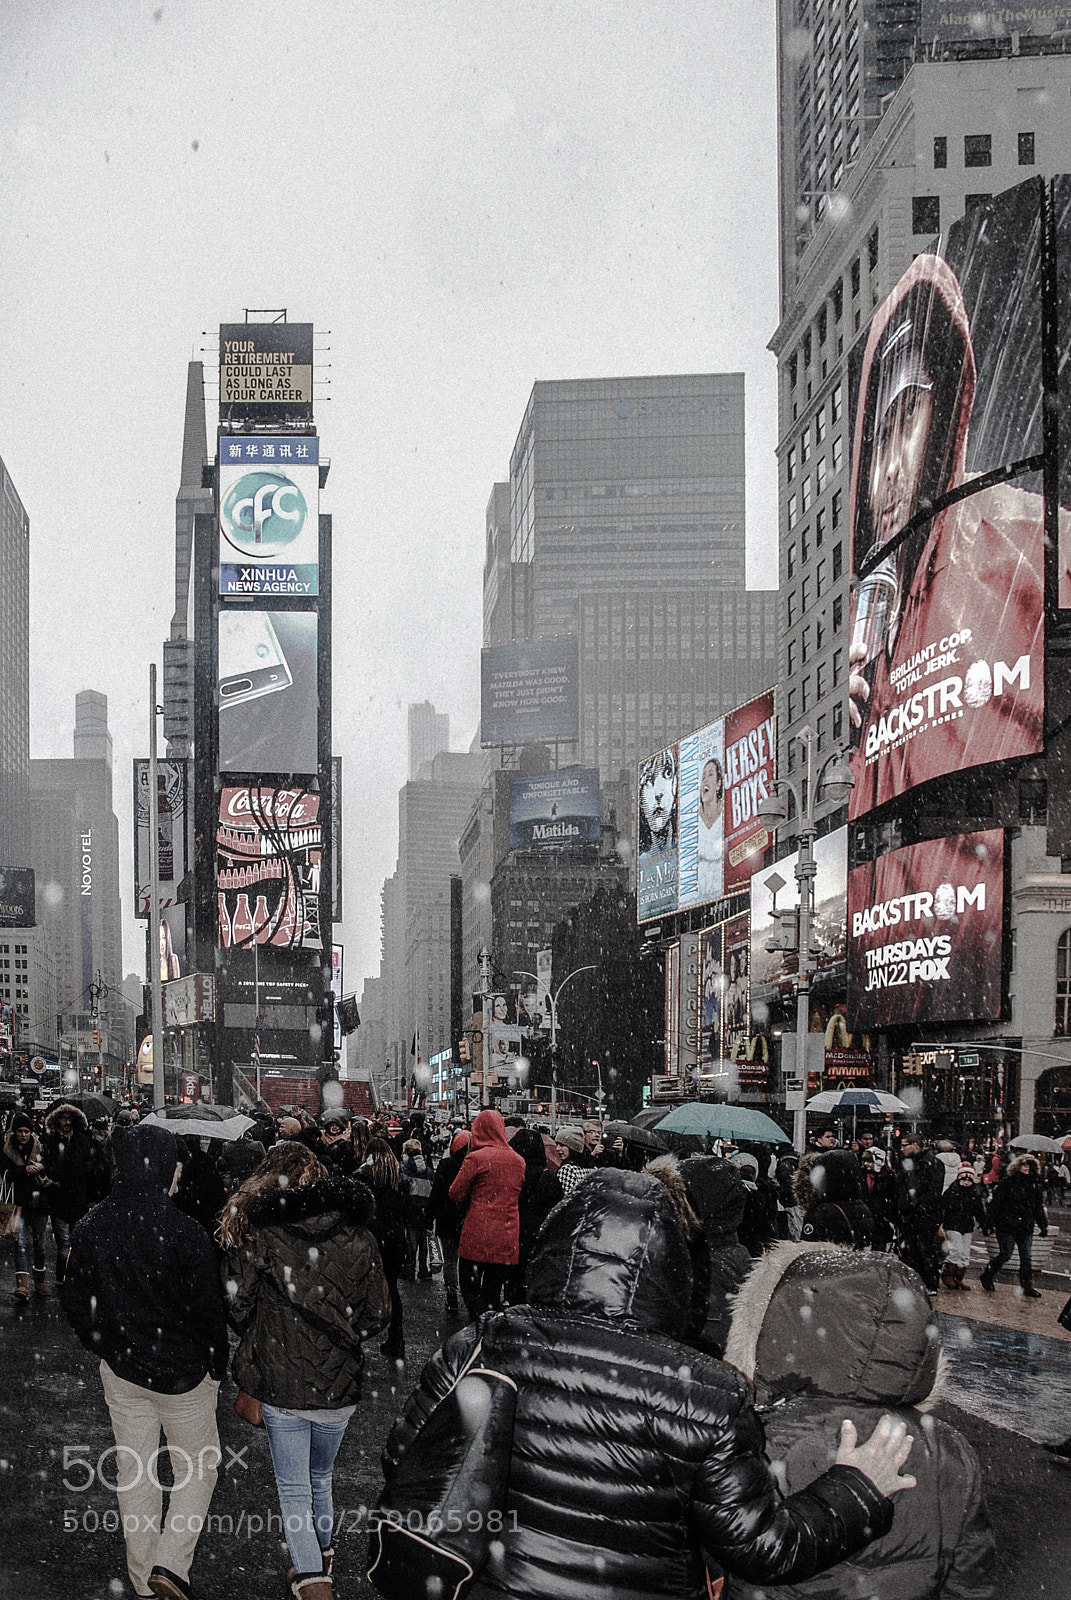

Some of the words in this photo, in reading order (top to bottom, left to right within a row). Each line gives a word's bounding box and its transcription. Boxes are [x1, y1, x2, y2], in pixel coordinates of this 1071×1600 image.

[224, 340, 255, 352] YOUR
[224, 352, 295, 364] RETIREMENT
[226, 366, 262, 377] COULD
[265, 366, 293, 377] LAST
[226, 378, 240, 389] AS
[244, 378, 273, 389] LONG
[276, 378, 291, 389] AS
[226, 389, 256, 400] YOUR
[259, 389, 303, 400] CAREER
[228, 444, 309, 458] 新华通讯社
[240, 568, 298, 581] XINHUA
[227, 582, 260, 592] NEWS
[263, 582, 311, 592] AGENCY
[890, 642, 937, 685] BRILLIANT
[939, 628, 973, 652] COP.
[895, 667, 922, 695] TOTAL
[923, 648, 961, 676] JERK.
[489, 680, 523, 690] MATILDA
[525, 678, 543, 687] WAS
[494, 690, 515, 699] THEY
[516, 688, 535, 697] JUST
[493, 700, 518, 708] KNOW
[520, 697, 539, 706] HOW
[724, 714, 774, 790] JERSEY
[865, 754, 879, 768] FROM
[880, 745, 891, 757] THE
[891, 729, 917, 750] CREATOR
[919, 723, 929, 733] OF
[560, 779, 579, 788] AND
[532, 821, 580, 840] Matilda
[679, 797, 699, 897] MAMMA
[81, 828, 92, 896] NOVOTEL
[852, 882, 986, 938] BACKSTROM
[865, 935, 951, 969] THURSDAYS
[909, 957, 951, 983] FOX
[686, 943, 697, 1046] PALACE
[186, 1075, 197, 1096] tkts
